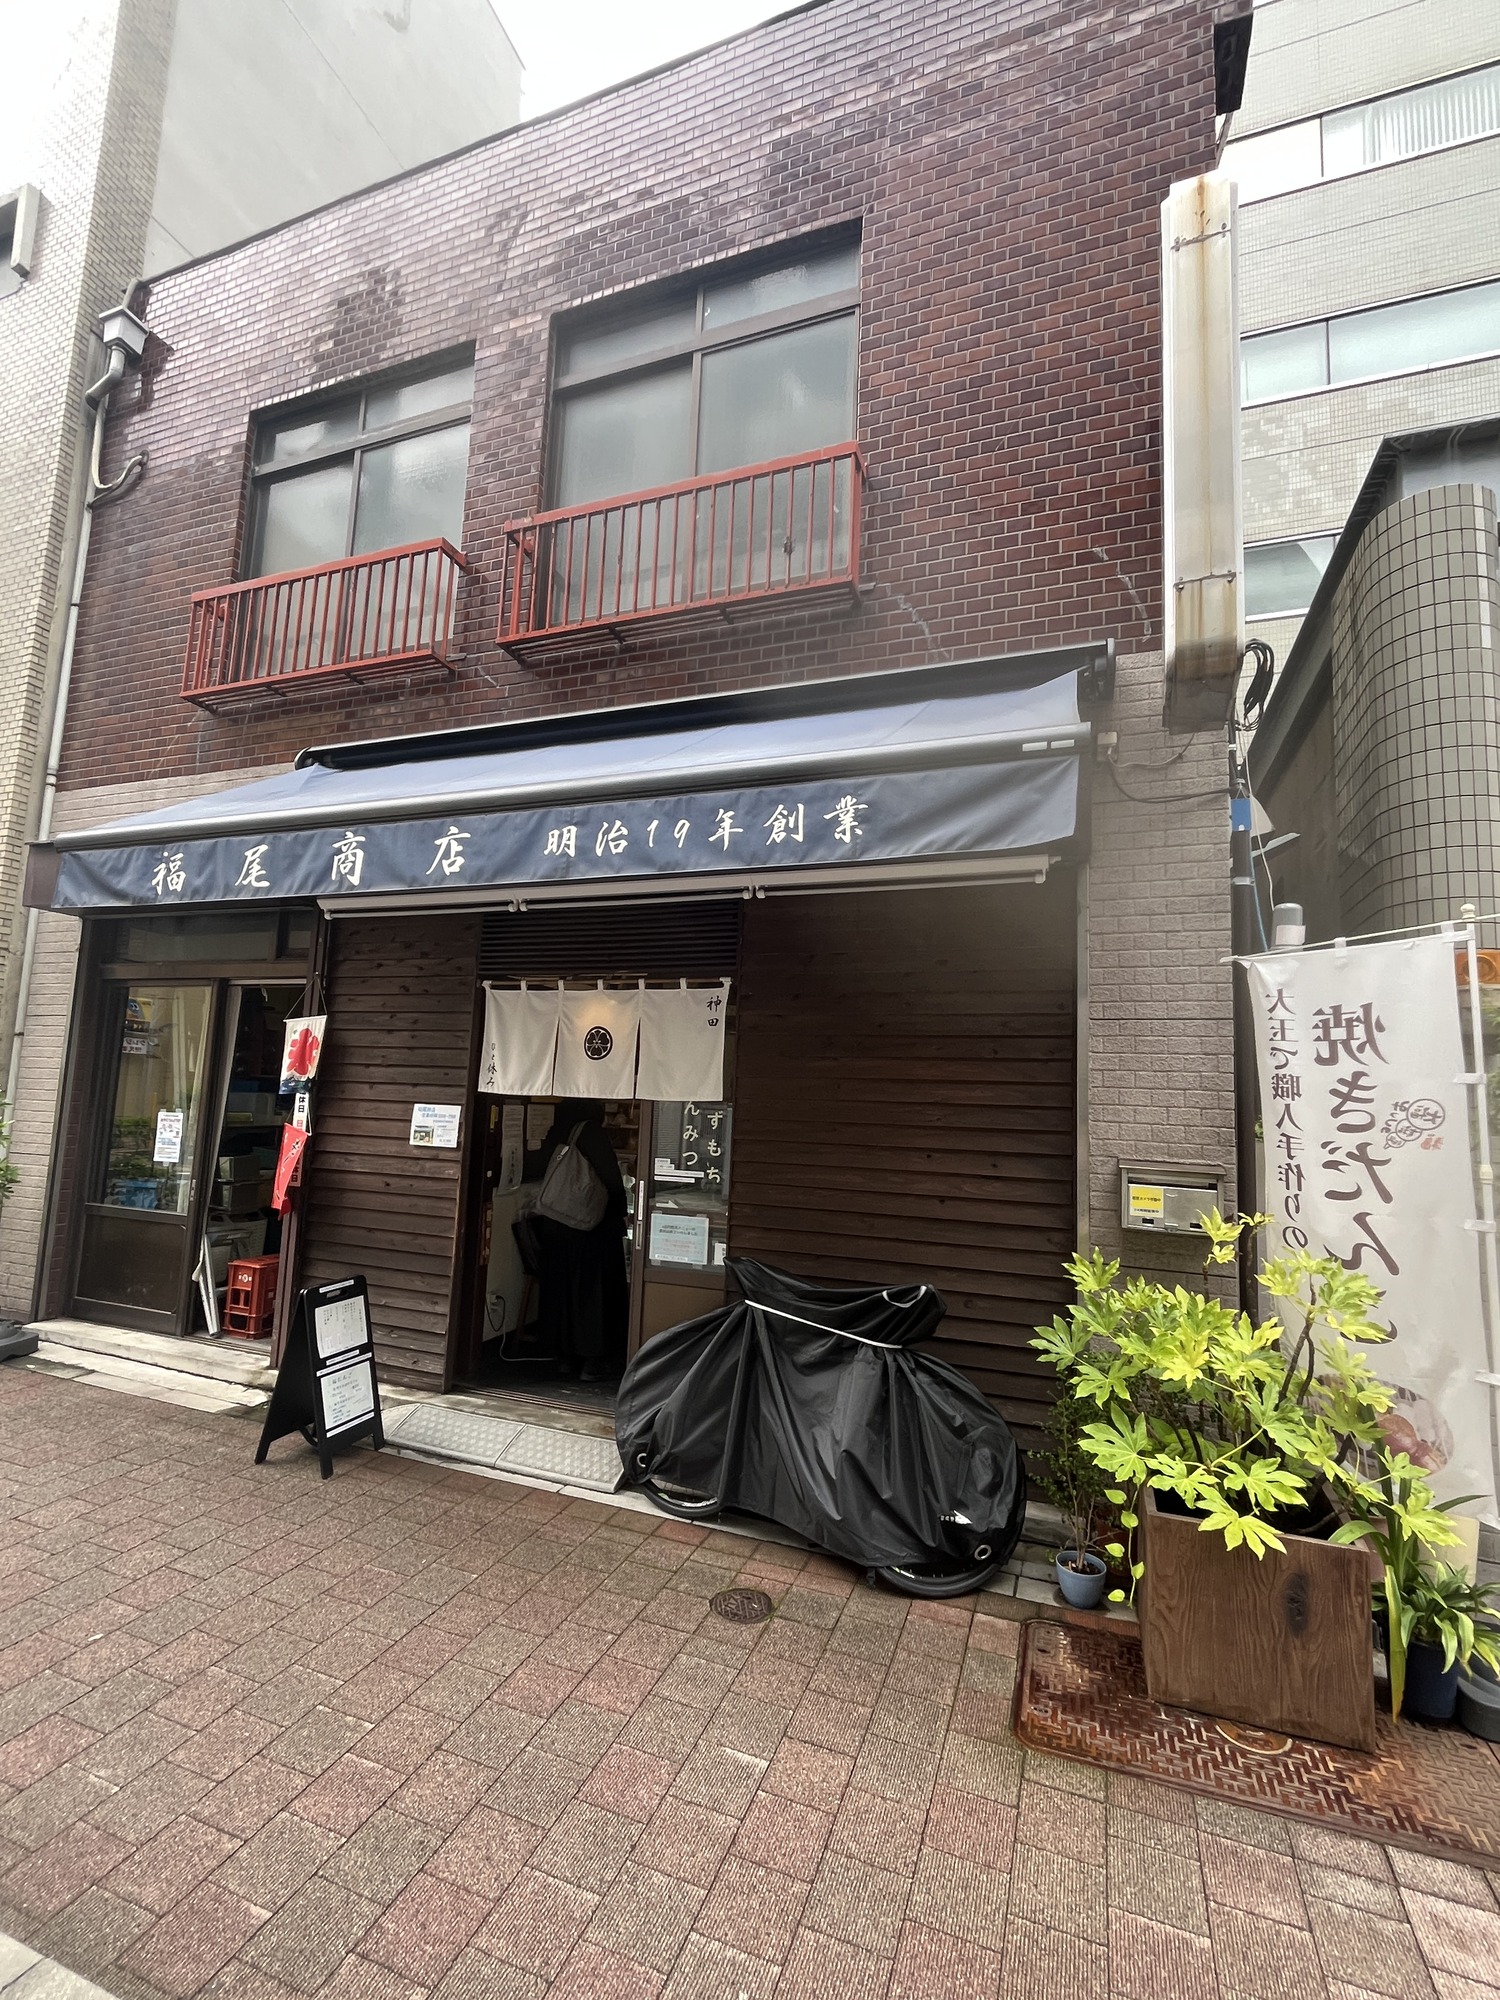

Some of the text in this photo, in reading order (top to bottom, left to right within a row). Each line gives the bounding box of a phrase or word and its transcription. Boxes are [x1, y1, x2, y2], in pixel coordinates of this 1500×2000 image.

[151, 795, 869, 896] 福尾商店 明治19年創業
[706, 995, 722, 1027] 神田
[286, 1027, 320, 1076] 氷
[486, 1042, 498, 1087] ひと休み
[706, 1110, 724, 1184] ずもち
